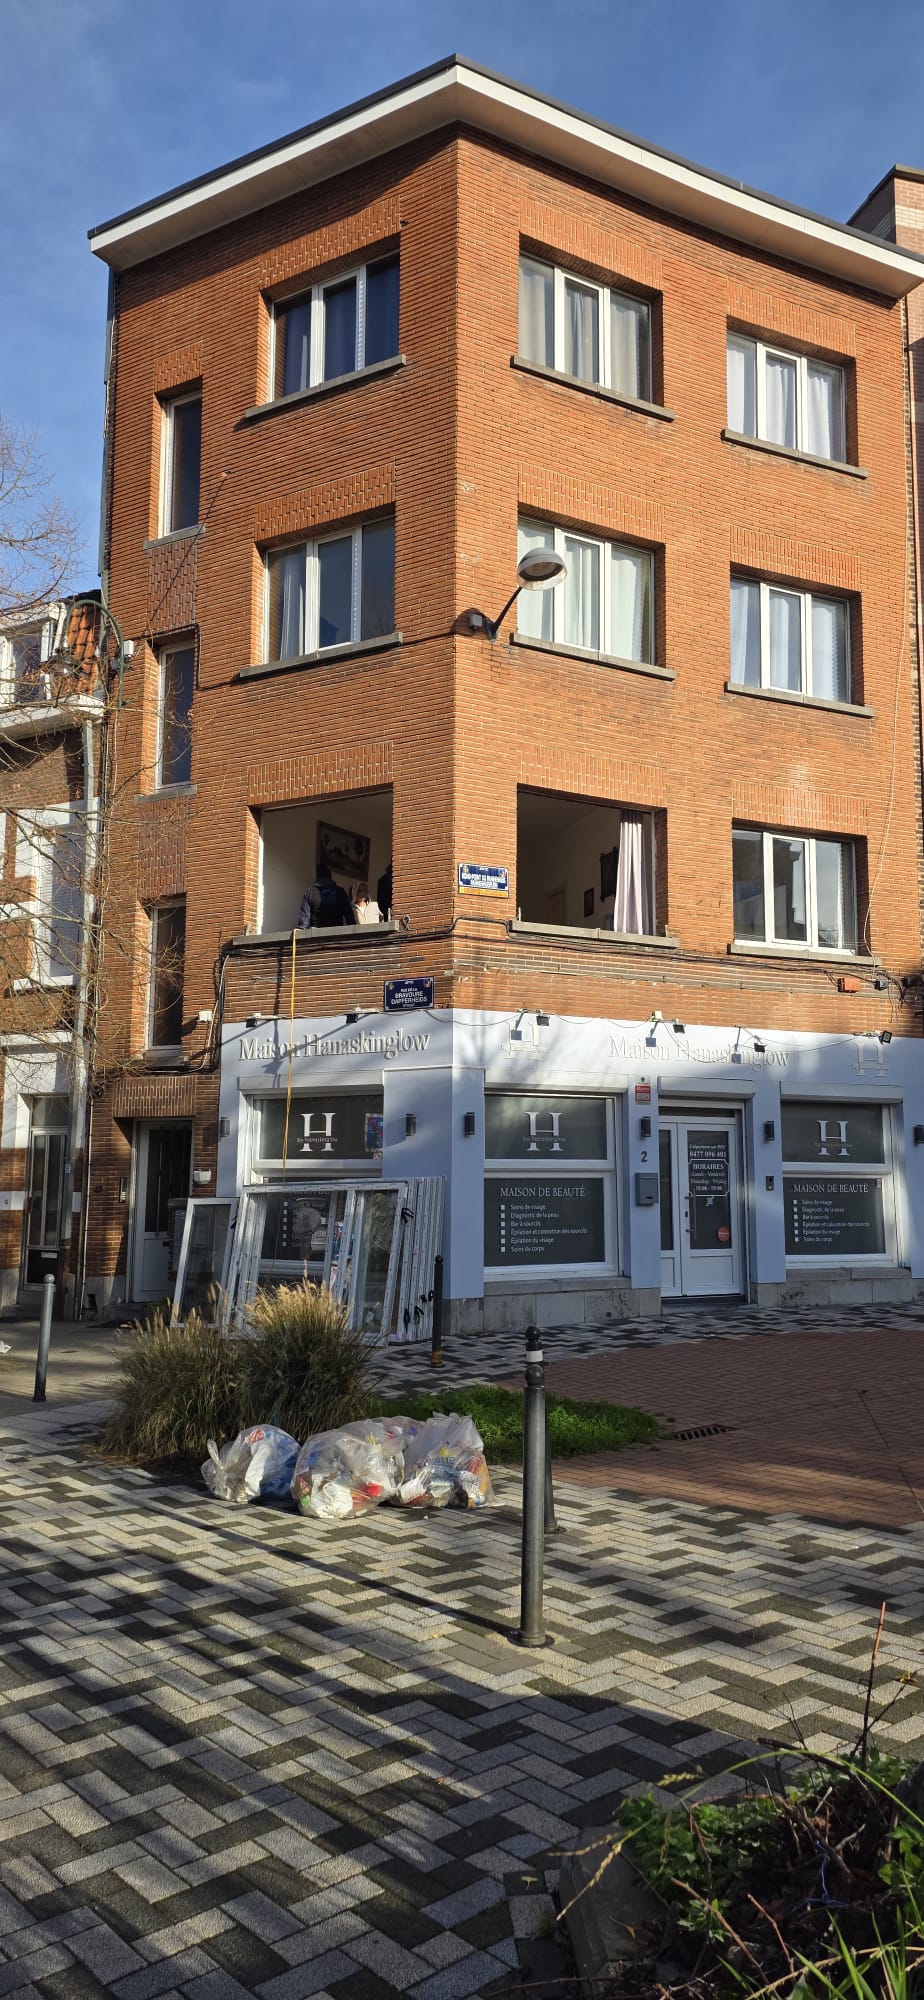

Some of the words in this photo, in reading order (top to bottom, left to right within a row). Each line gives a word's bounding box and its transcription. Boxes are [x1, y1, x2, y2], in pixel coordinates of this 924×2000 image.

[239, 1037, 300, 1061] Maison
[304, 1027, 432, 1060] Hanaskinglow
[608, 1034, 671, 1060] Maison
[300, 1112, 336, 1152] H
[525, 1112, 563, 1151] H
[816, 1120, 850, 1156] H
[641, 1151, 648, 1162] 2
[500, 1188, 536, 1197] MAISON
[538, 1188, 550, 1197] DE
[552, 1185, 585, 1197] BEAUTÉ
[794, 1184, 825, 1192] MAISON
[827, 1184, 837, 1192] DE
[840, 1182, 868, 1192] BEAUTÉ
